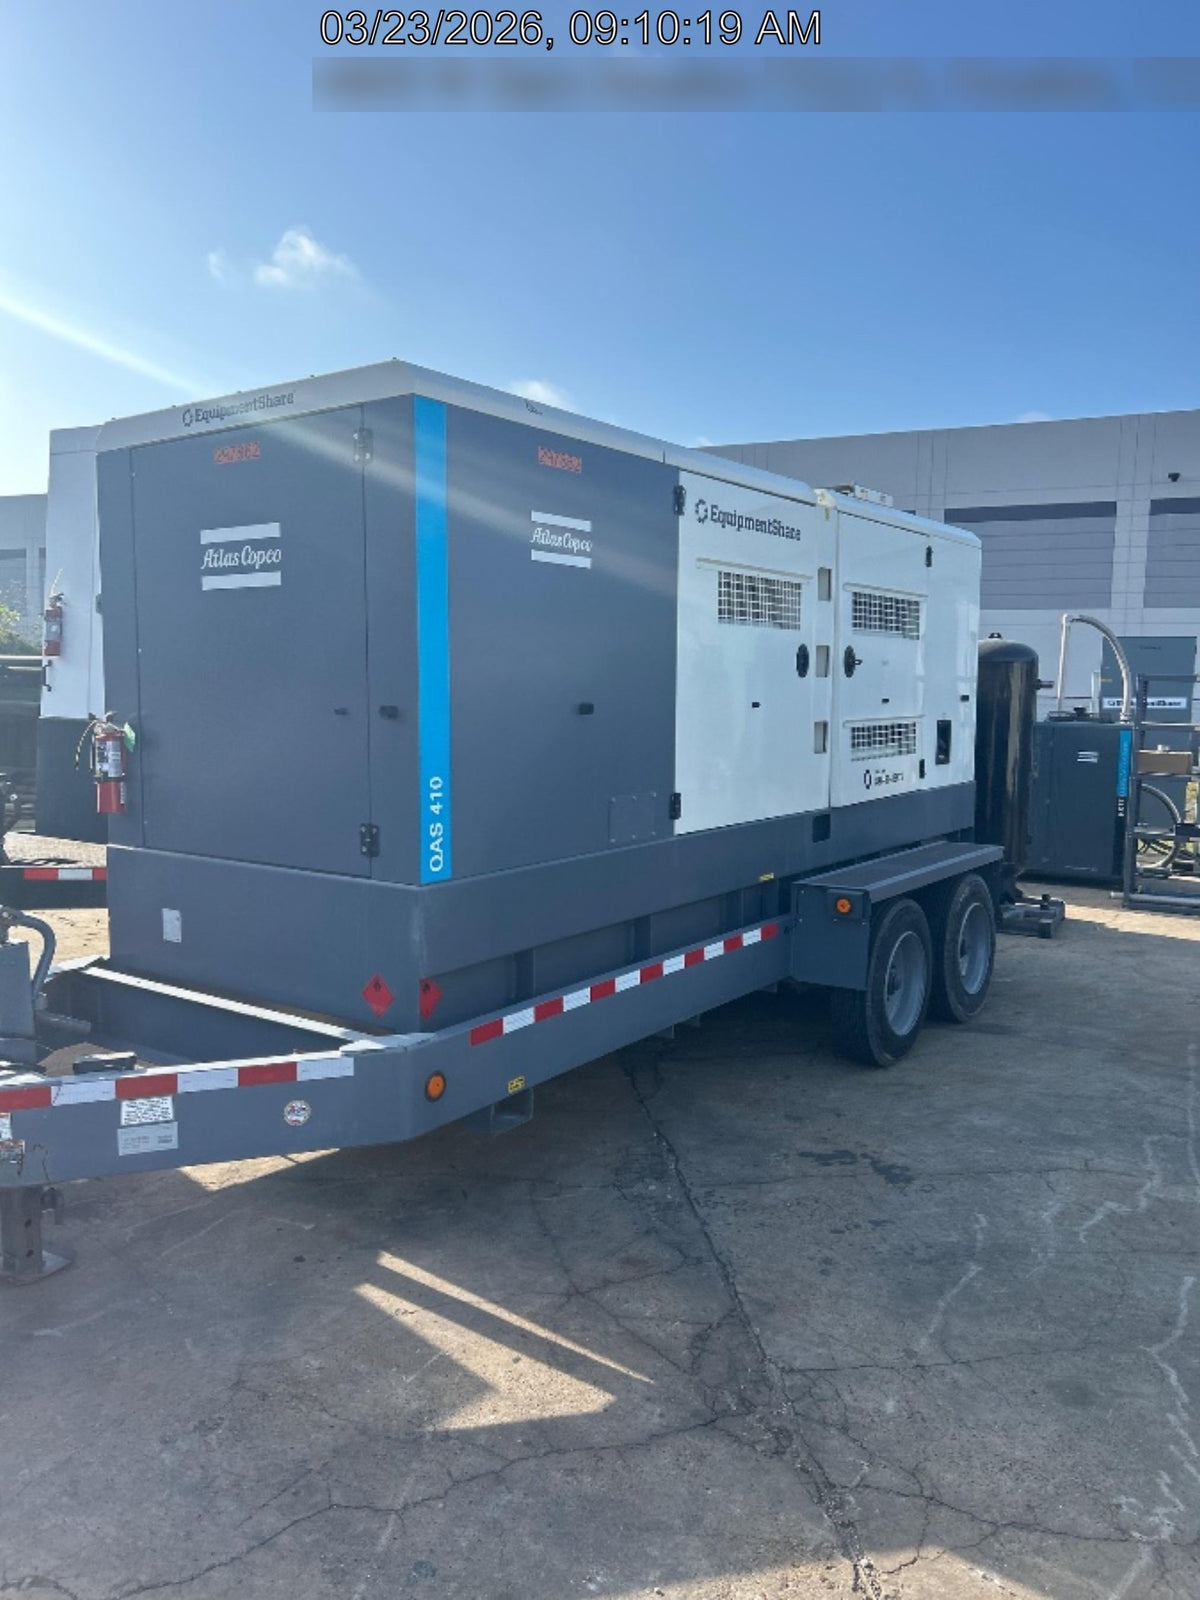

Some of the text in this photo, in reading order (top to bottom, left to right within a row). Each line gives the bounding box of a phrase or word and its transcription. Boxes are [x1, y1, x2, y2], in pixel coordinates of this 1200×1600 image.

[194, 393, 295, 424] EquipmentShare
[710, 504, 801, 541] EquipmentShare
[429, 776, 444, 872] QAS 410
